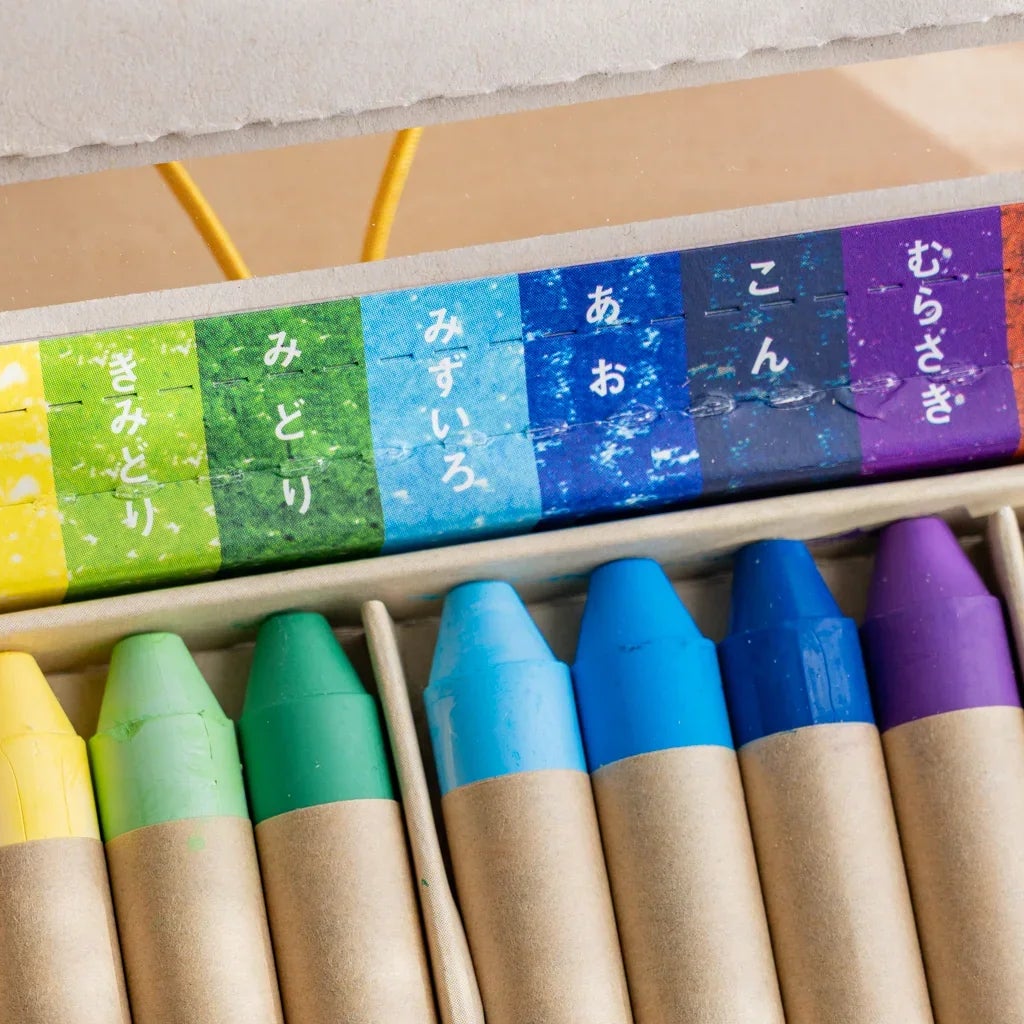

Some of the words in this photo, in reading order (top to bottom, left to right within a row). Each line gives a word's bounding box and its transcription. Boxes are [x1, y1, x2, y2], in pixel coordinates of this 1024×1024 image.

[423, 307, 476, 493] みずいろ
[585, 285, 627, 397] あお
[747, 260, 789, 375] こん
[907, 239, 954, 425] むらさき
[108, 347, 155, 537] きみどり
[263, 330, 312, 515] みどり
